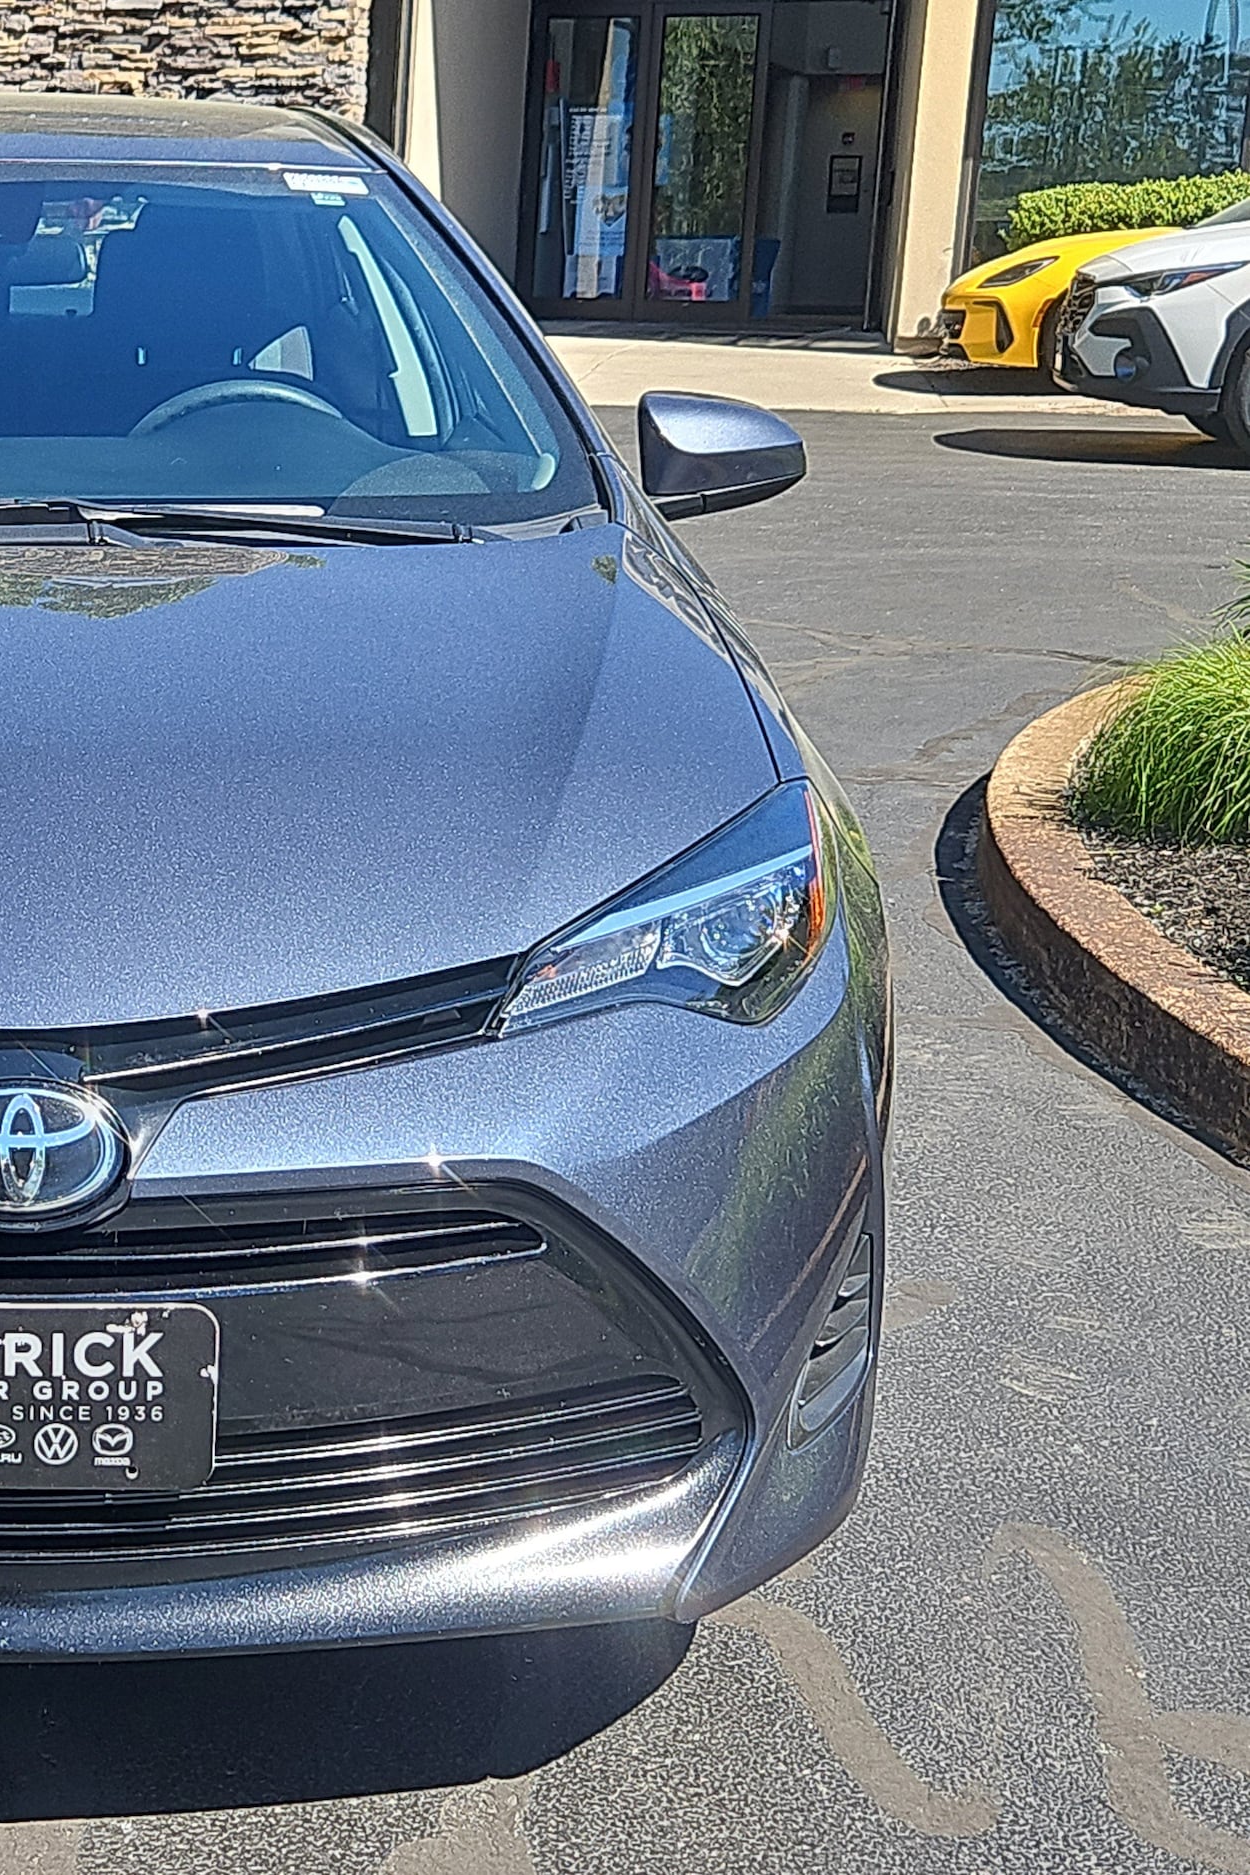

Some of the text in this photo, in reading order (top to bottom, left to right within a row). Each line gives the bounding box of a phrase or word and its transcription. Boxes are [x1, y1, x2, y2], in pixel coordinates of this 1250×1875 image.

[32, 1379, 164, 1401] GROUP
[12, 1405, 91, 1422] SINCE
[105, 1405, 164, 1422] 1936
